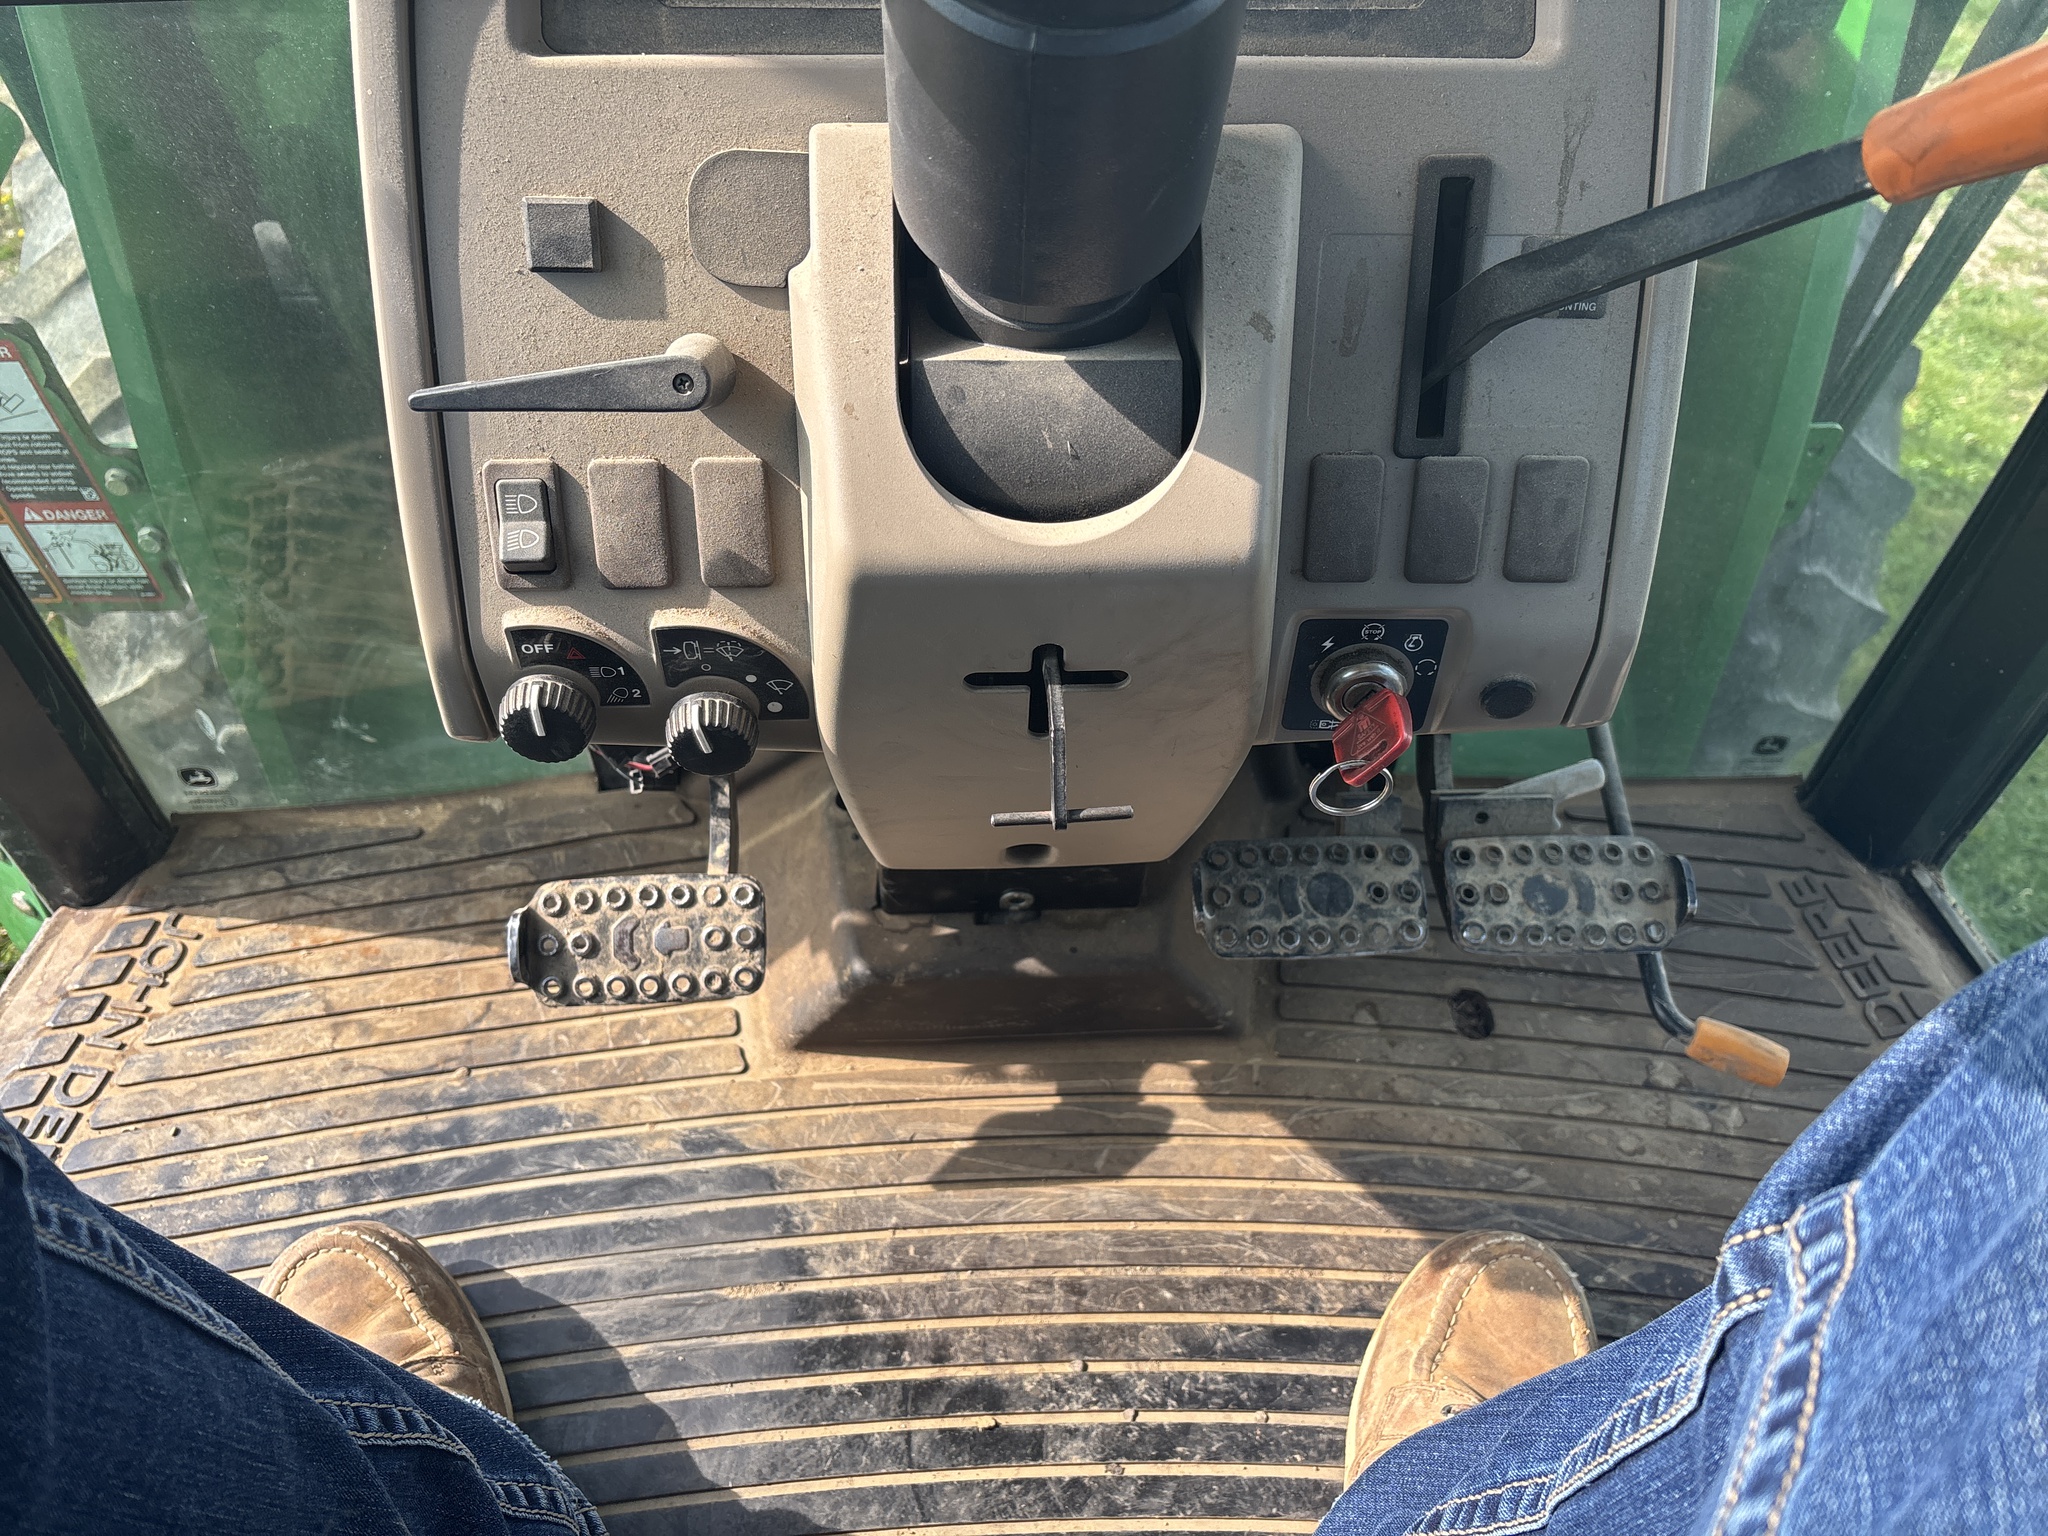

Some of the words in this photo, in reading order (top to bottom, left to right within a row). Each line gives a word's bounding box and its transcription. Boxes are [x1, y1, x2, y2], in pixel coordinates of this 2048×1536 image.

[1559, 302, 1597, 311] NTING
[42, 509, 109, 521] DANGER
[521, 643, 554, 655] OFF
[617, 666, 626, 676] 1
[631, 688, 642, 699] 2
[84, 912, 201, 1050] JOHN
